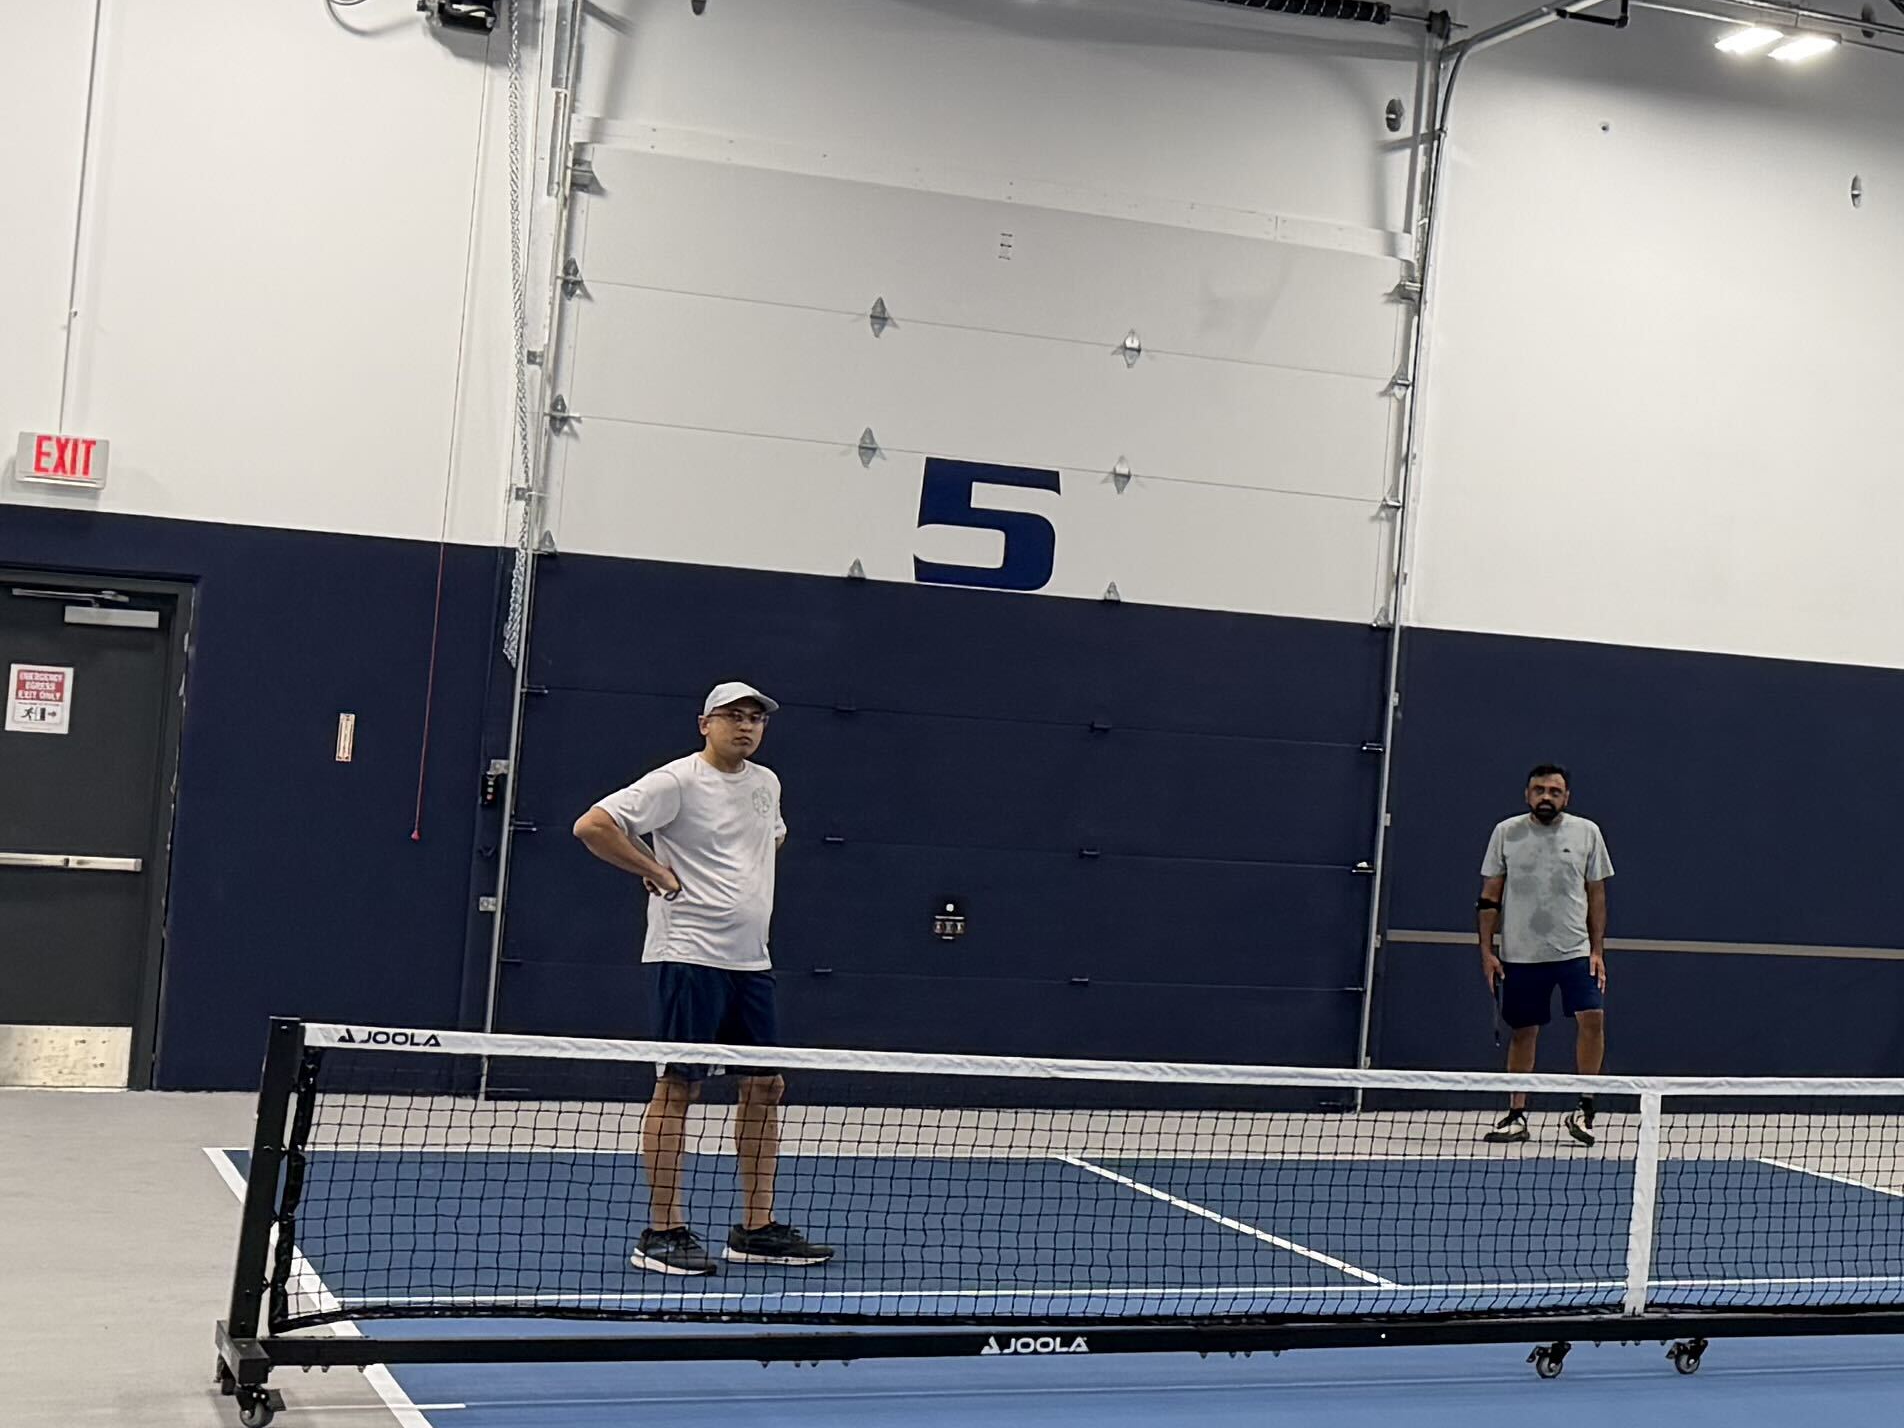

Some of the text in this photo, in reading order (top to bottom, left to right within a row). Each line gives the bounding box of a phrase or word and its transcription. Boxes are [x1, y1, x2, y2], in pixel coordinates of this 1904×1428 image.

[34, 435, 97, 477] EXIT
[913, 456, 1061, 592] 5
[39, 691, 61, 700] ONLY
[359, 1030, 441, 1047] JOOLA
[1002, 1336, 1090, 1353] JOOLA
